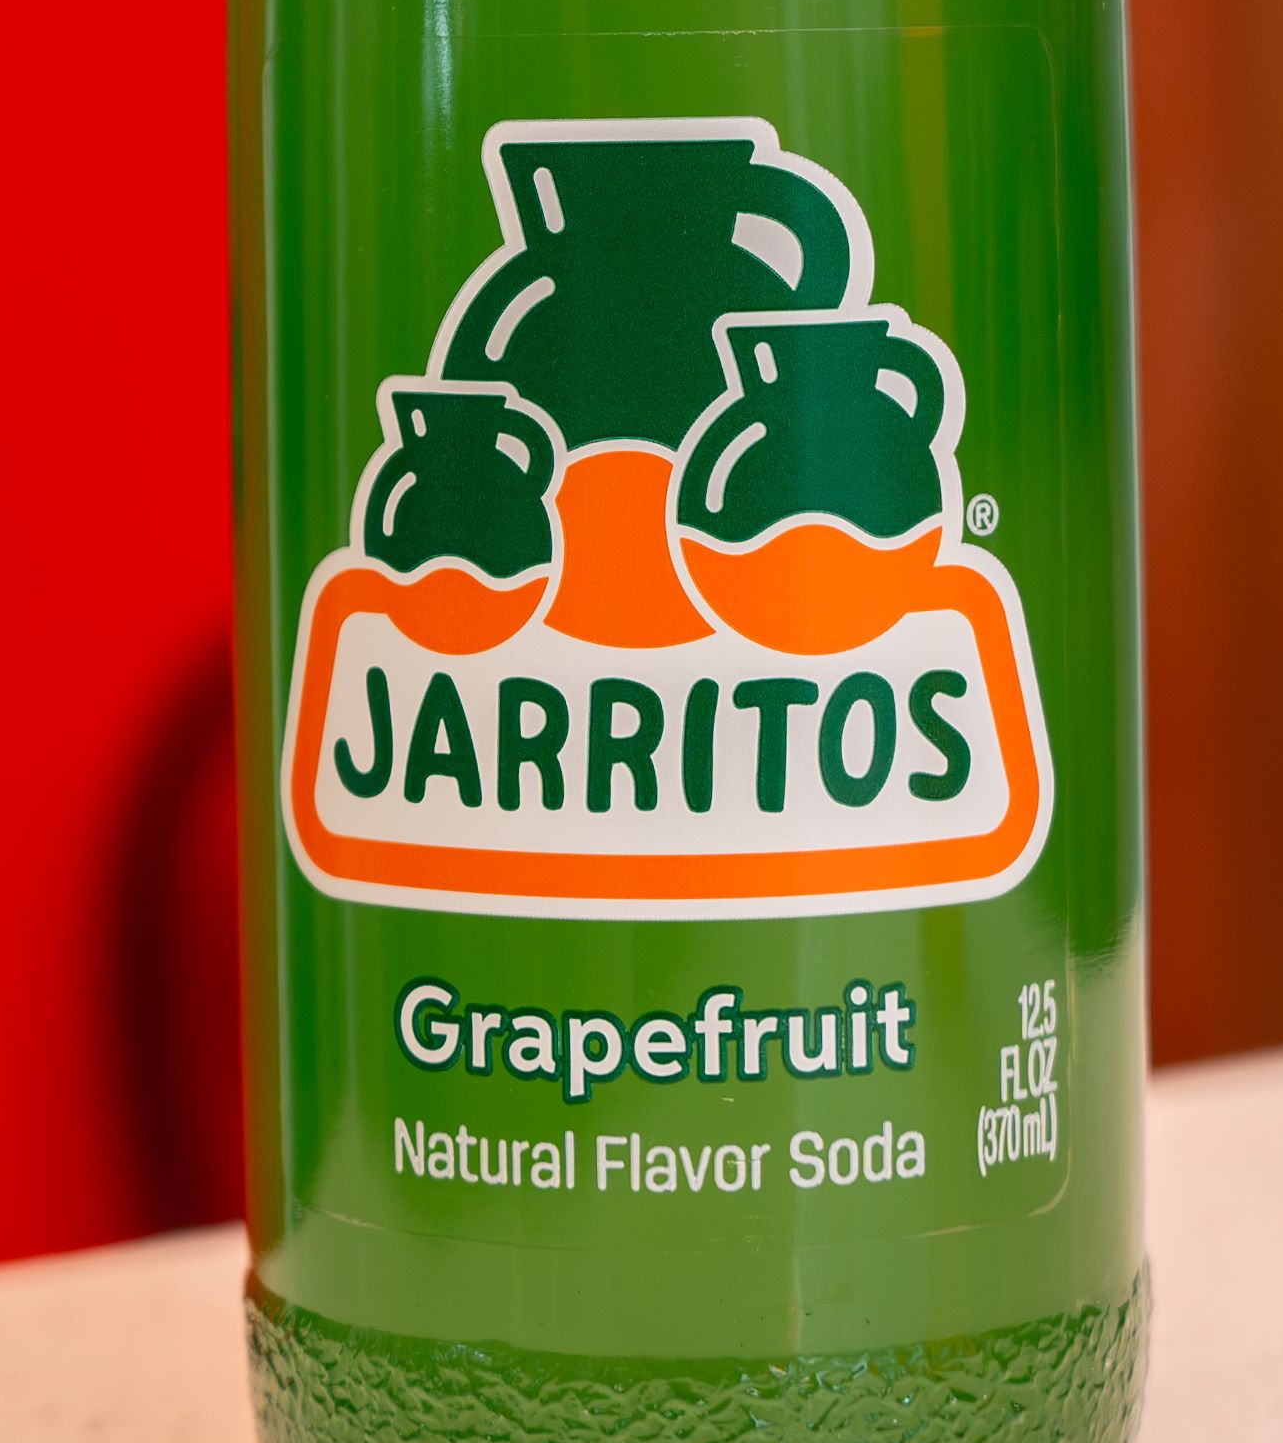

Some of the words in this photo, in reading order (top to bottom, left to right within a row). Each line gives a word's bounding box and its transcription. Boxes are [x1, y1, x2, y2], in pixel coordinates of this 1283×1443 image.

[334, 666, 971, 814] JARRITOS
[396, 979, 914, 1101] Grapefruit
[1018, 979, 1056, 1040] 12.5
[1000, 1044, 1028, 1103] FL
[1027, 1036, 1058, 1098] OZ
[394, 1117, 575, 1190] Natural
[596, 1132, 771, 1193] Flavor
[788, 1120, 926, 1189] Soda
[977, 1105, 1021, 1178] (370
[1022, 1091, 1058, 1163] mL)
